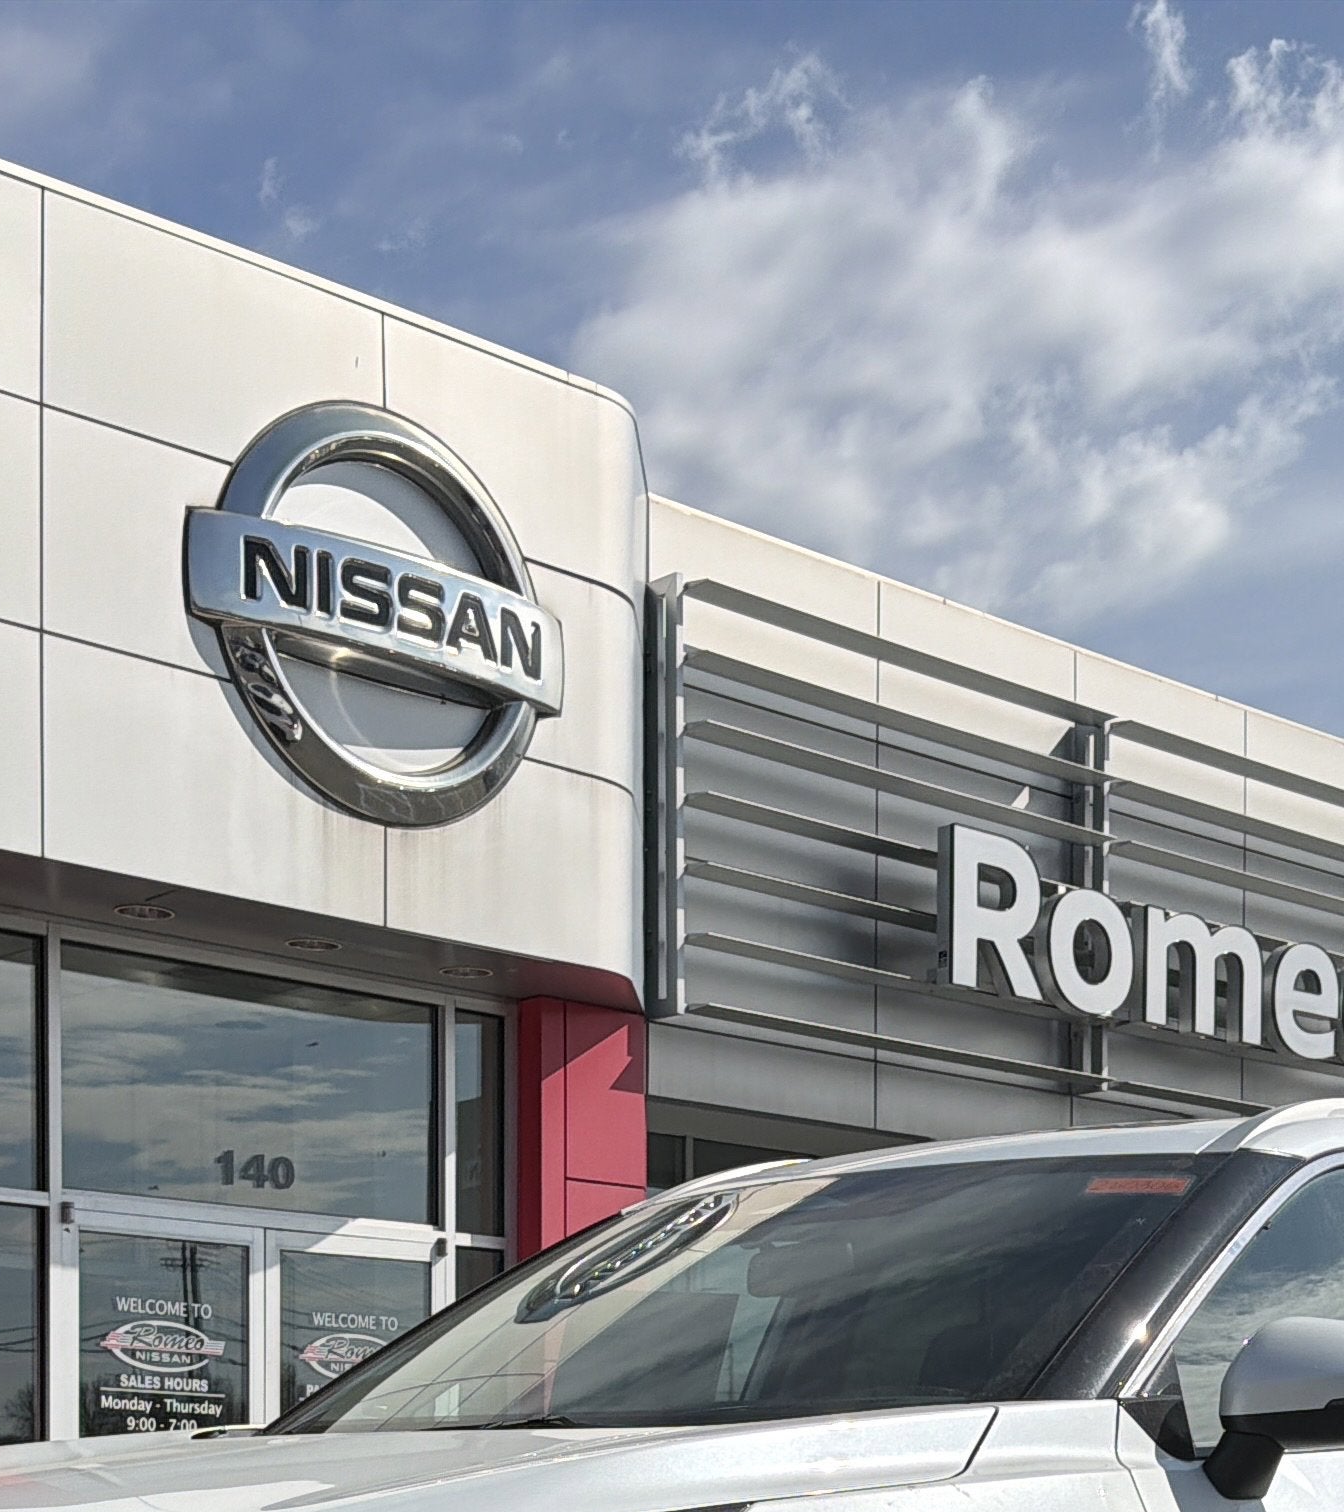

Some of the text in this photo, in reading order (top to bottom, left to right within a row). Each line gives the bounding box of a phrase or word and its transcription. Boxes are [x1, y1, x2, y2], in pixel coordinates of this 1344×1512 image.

[240, 534, 543, 686] NISSAN
[215, 1150, 295, 1190] 140
[115, 1296, 212, 1319] WELCOME TO
[312, 1312, 398, 1331] WELCOME TO
[125, 1323, 205, 1351] Romeo
[324, 1337, 376, 1360] Rom
[136, 1351, 190, 1364] NISSAN
[120, 1374, 208, 1392] SALES HOURS
[100, 1395, 153, 1413] Monday
[164, 1399, 223, 1418] Thursday
[126, 1416, 156, 1431] 9:00
